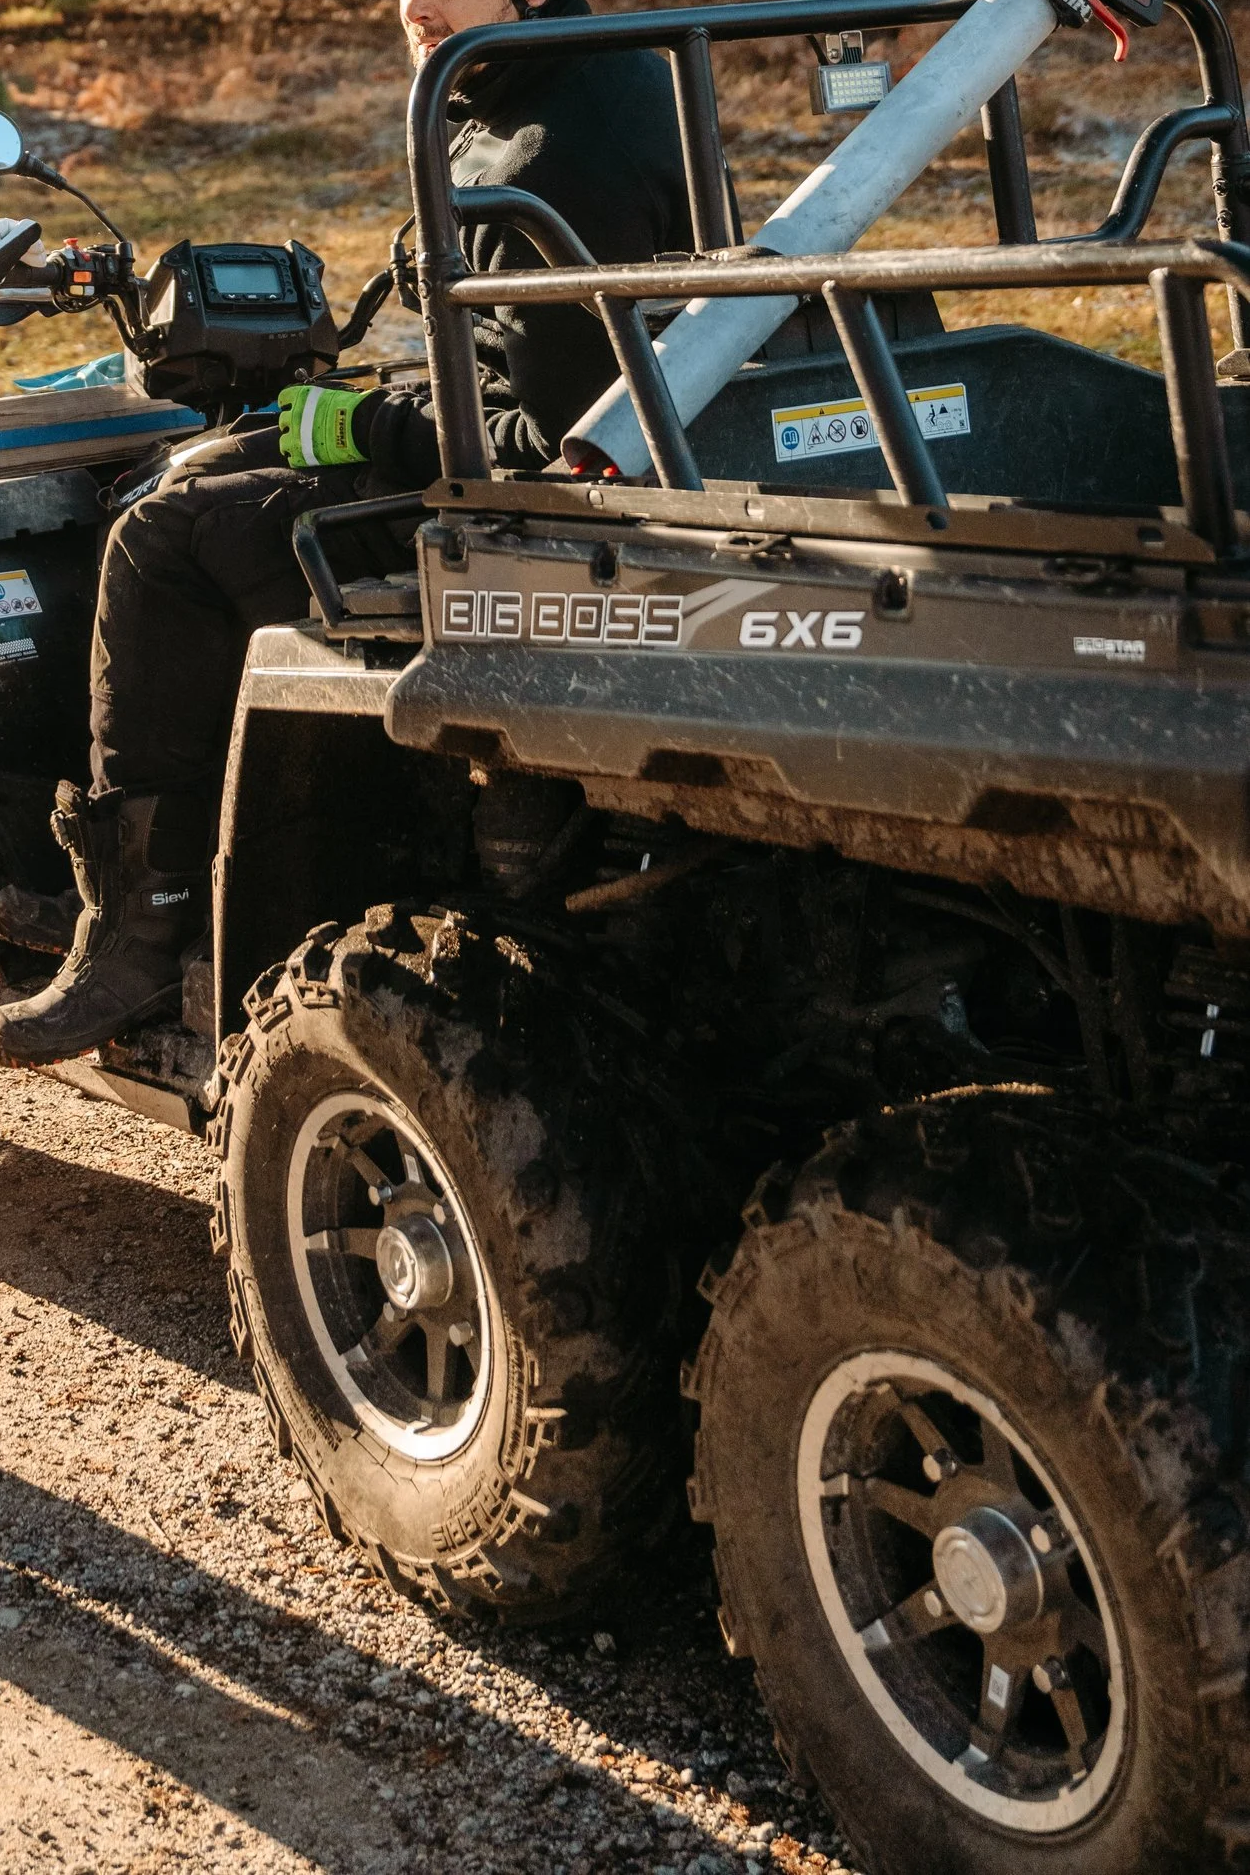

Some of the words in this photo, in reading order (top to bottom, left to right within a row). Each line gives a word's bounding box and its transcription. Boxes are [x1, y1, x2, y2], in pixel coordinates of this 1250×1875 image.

[441, 589, 523, 640] BIG
[529, 591, 685, 647] BOSS
[151, 888, 189, 906] Sievi
